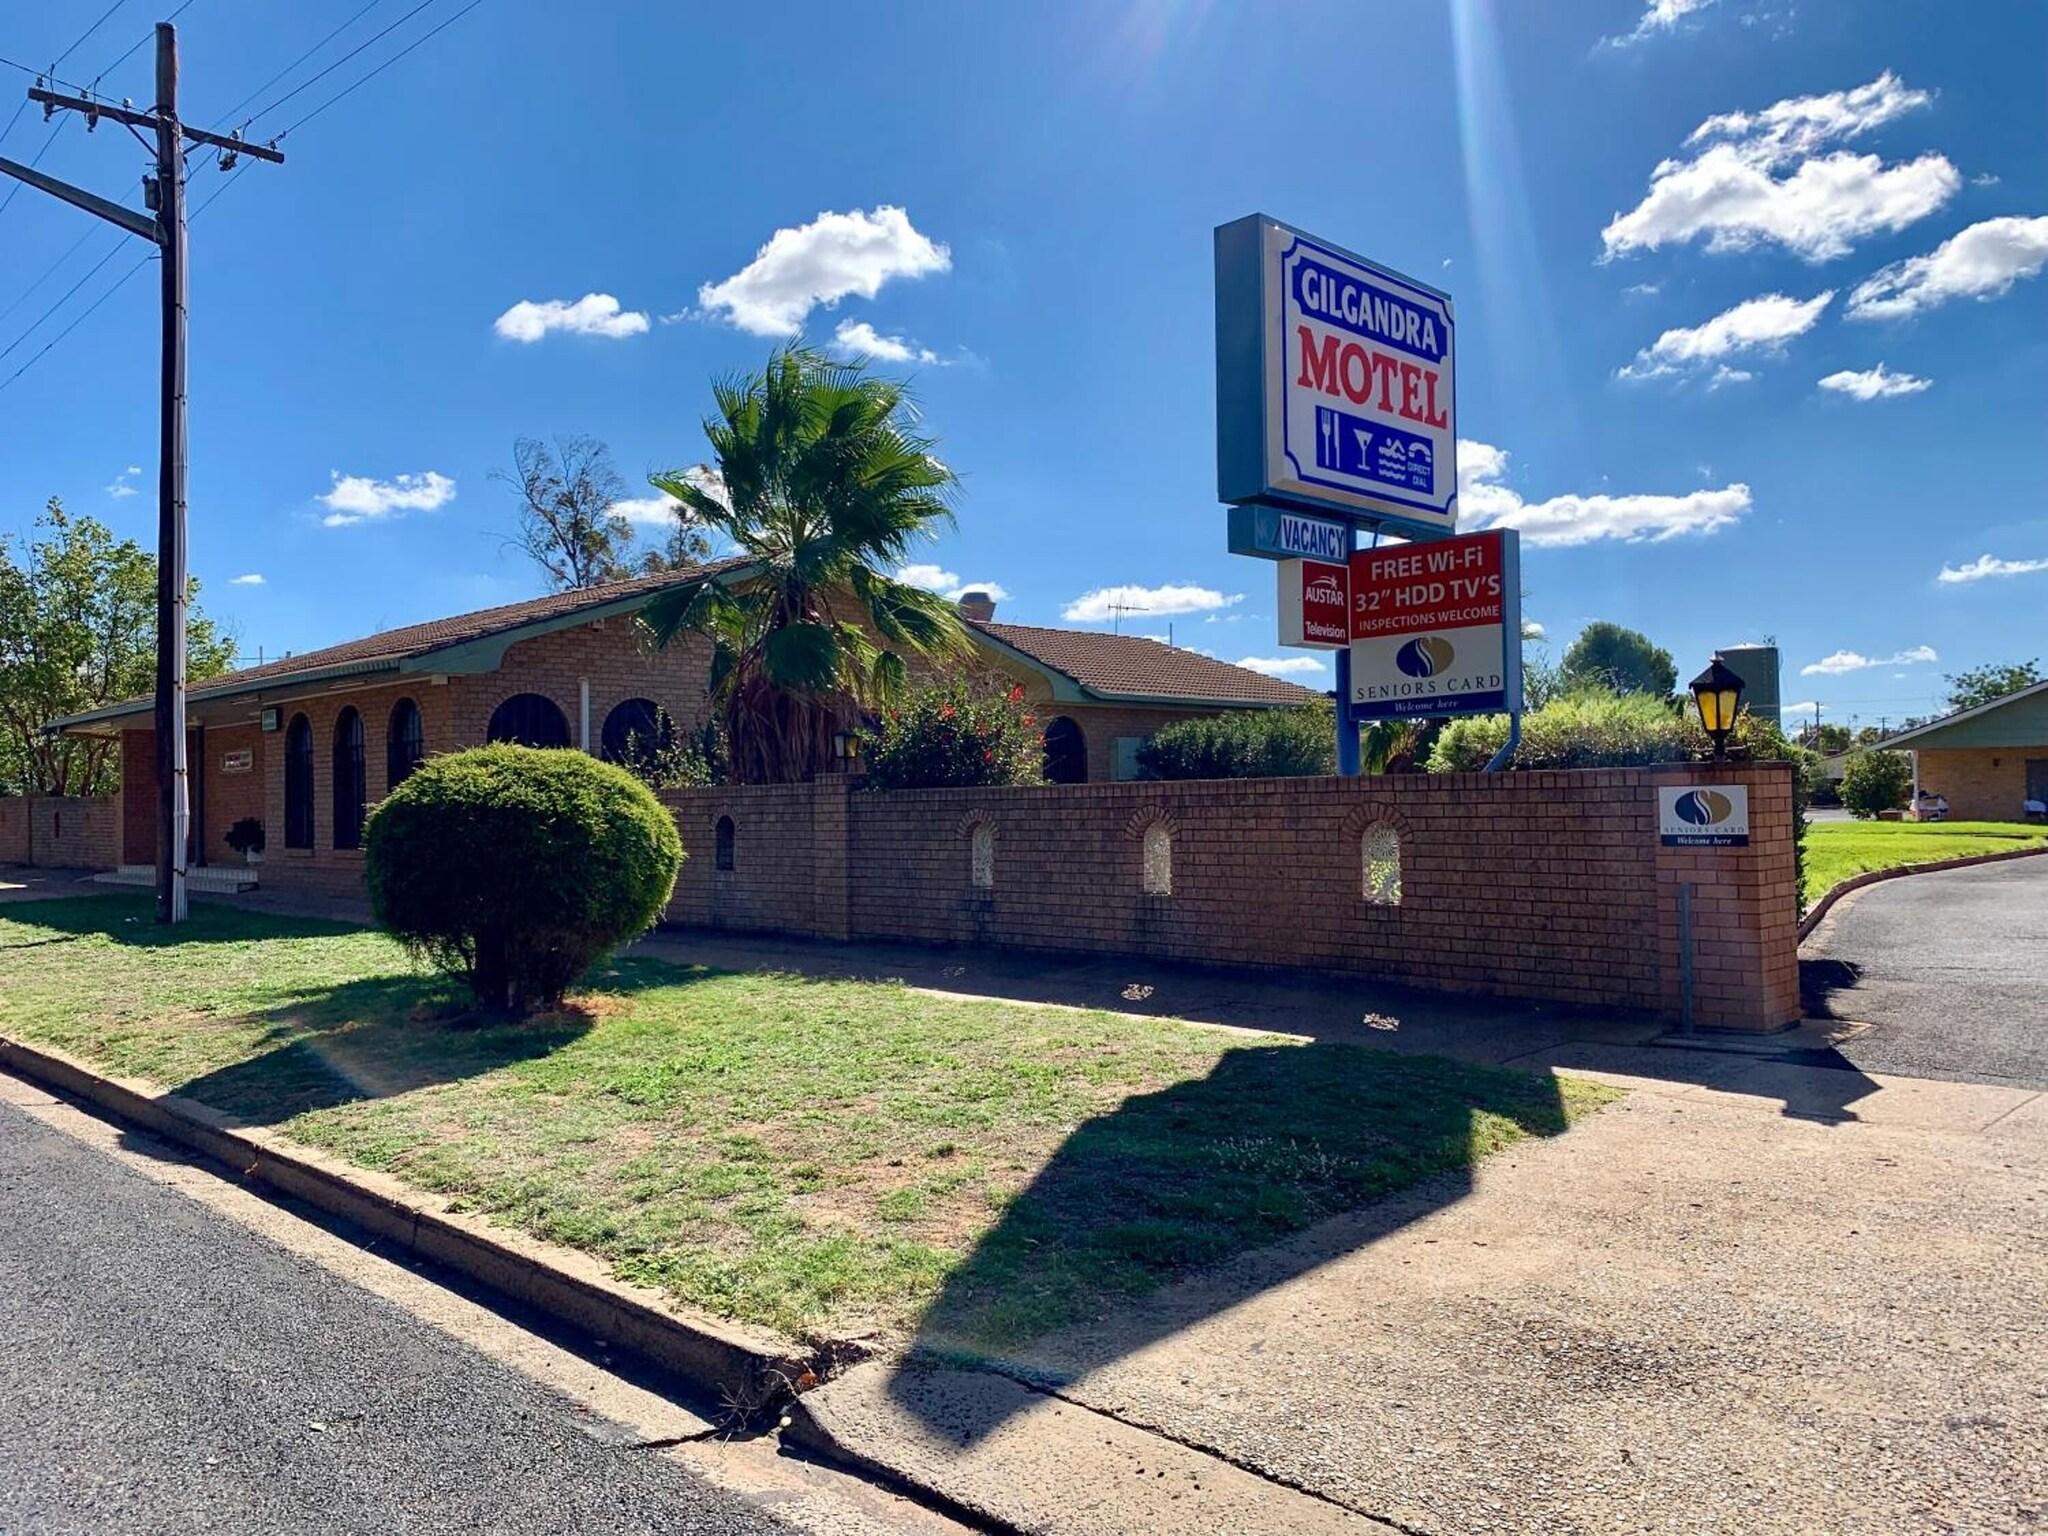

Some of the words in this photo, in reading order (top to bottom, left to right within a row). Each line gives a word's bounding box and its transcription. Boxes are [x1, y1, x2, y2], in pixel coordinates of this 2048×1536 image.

[1301, 267, 1438, 355] GILGANDRA
[1297, 325, 1448, 430] MOTEL
[1412, 475, 1428, 488] DIAL
[1282, 517, 1345, 558] VACANCY
[1371, 555, 1423, 581] FREE
[1427, 545, 1483, 573] Wi-Fi
[1305, 586, 1344, 606] AUSTAR
[1395, 582, 1445, 608] HDD
[1449, 574, 1500, 600] TV'S
[1304, 621, 1346, 639] Television
[1359, 612, 1436, 631] INSPECTIONS
[1437, 604, 1500, 622] WELCOME
[1356, 680, 1436, 700] SENIORS
[1447, 675, 1500, 692] CARD
[1394, 701, 1433, 713] Welcome
[1436, 698, 1459, 709] here
[1664, 825, 1709, 834] SENIORS
[1714, 825, 1745, 834] CARD
[1677, 835, 1710, 845] Welcome
[1712, 835, 1732, 845] here
